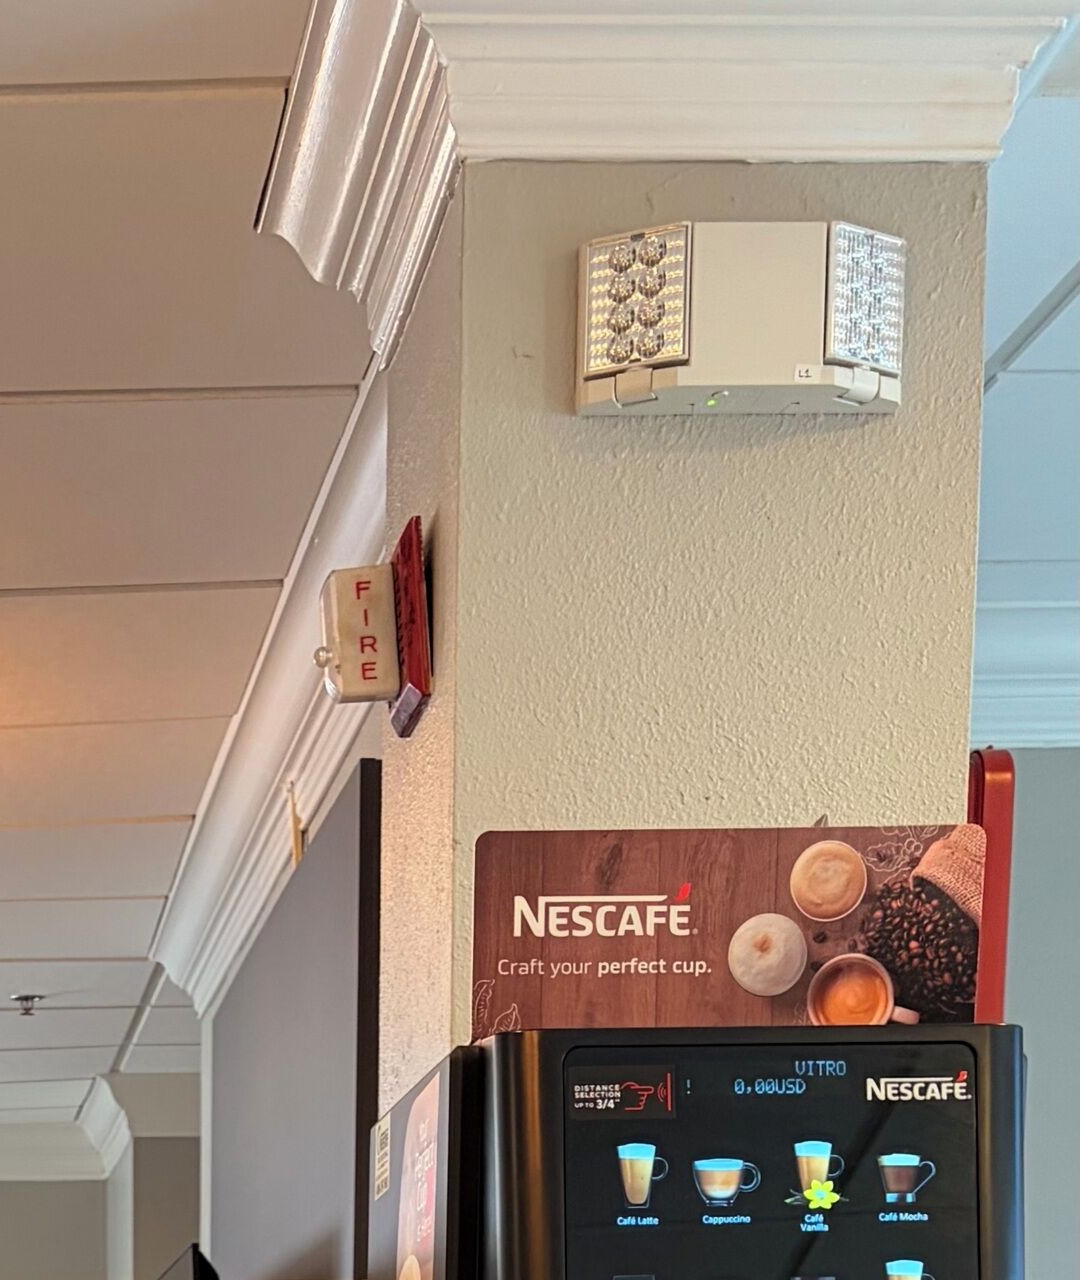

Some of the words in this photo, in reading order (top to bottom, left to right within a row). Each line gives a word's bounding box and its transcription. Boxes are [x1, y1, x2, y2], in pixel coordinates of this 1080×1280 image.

[354, 580, 378, 681] FIRE
[512, 882, 692, 938] NESCAFÉ
[497, 958, 545, 975] Craft
[550, 961, 593, 978] your
[598, 958, 667, 978] perfect
[672, 960, 712, 977] cup.
[795, 1060, 847, 1076] VITRO
[574, 1084, 620, 1092] DISTANCE
[734, 1078, 806, 1095] 0,00USD
[574, 1091, 621, 1099] SELECTION
[617, 1216, 636, 1226] Café
[637, 1216, 659, 1226] Latte
[702, 1215, 751, 1225] Cappuccino
[805, 1213, 824, 1223] Café
[879, 1212, 898, 1222] Café
[899, 1212, 929, 1222] Mocha
[800, 1223, 829, 1232] Vanilla
